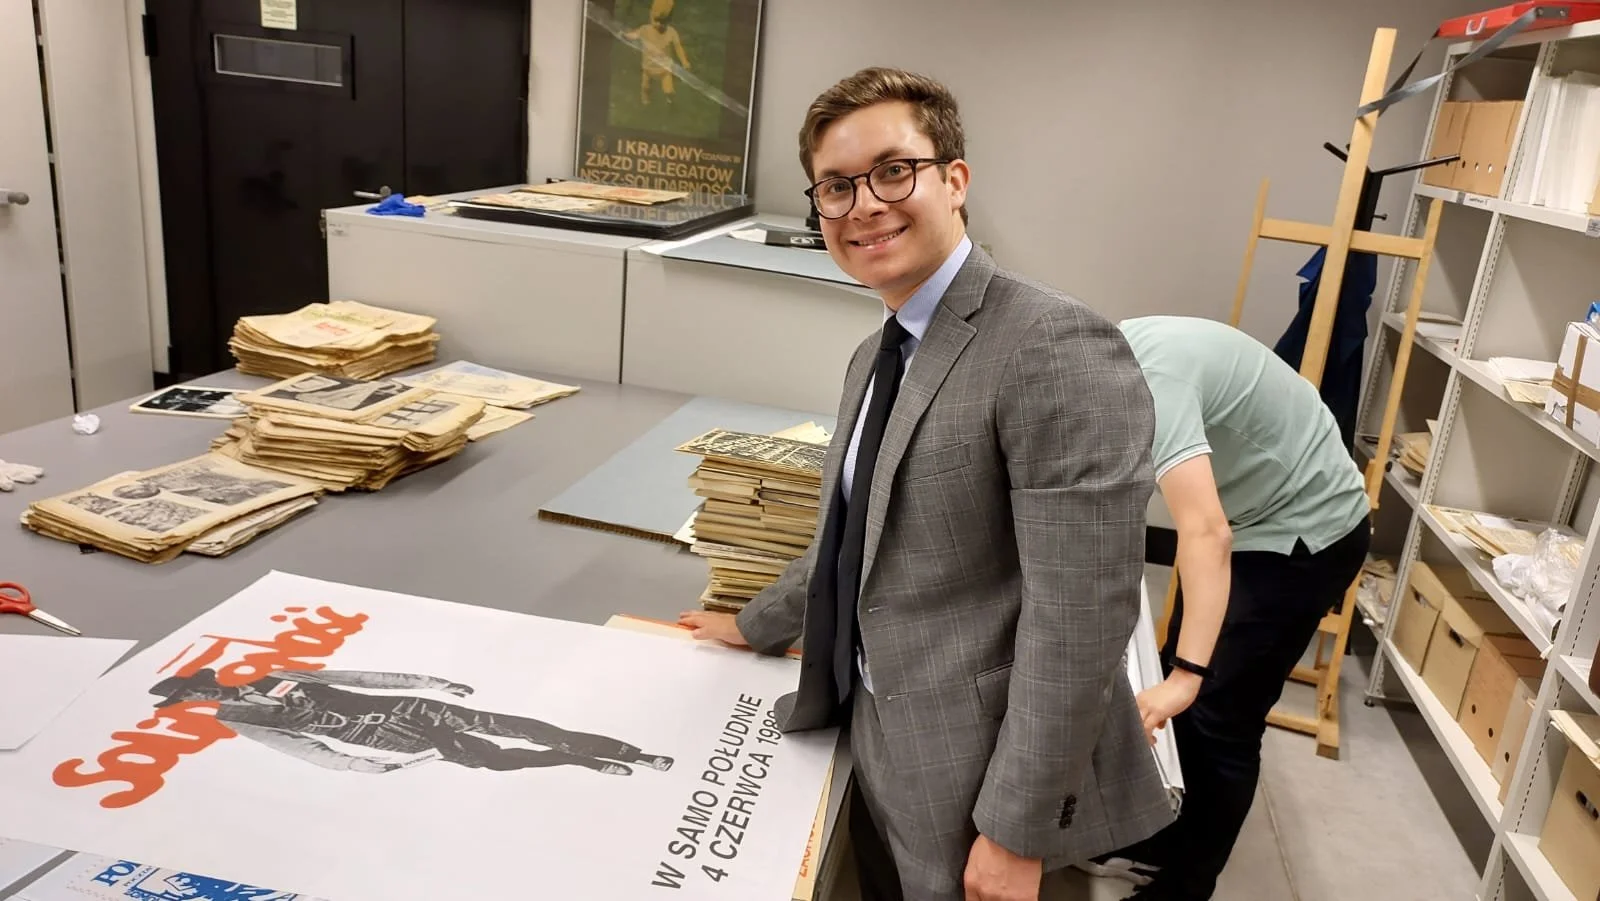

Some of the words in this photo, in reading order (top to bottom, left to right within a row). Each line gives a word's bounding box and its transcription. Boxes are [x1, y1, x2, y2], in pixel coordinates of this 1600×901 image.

[617, 139, 623, 154] I
[625, 140, 703, 162] KRAJOWY
[585, 152, 633, 171] ZJAZD
[637, 160, 734, 183] DELEGATÓW
[701, 693, 762, 787] POŁUDNIE
[709, 752, 774, 860] CZERWCA
[667, 790, 719, 860] SAMO
[651, 861, 686, 889] W
[701, 865, 729, 882] 4
